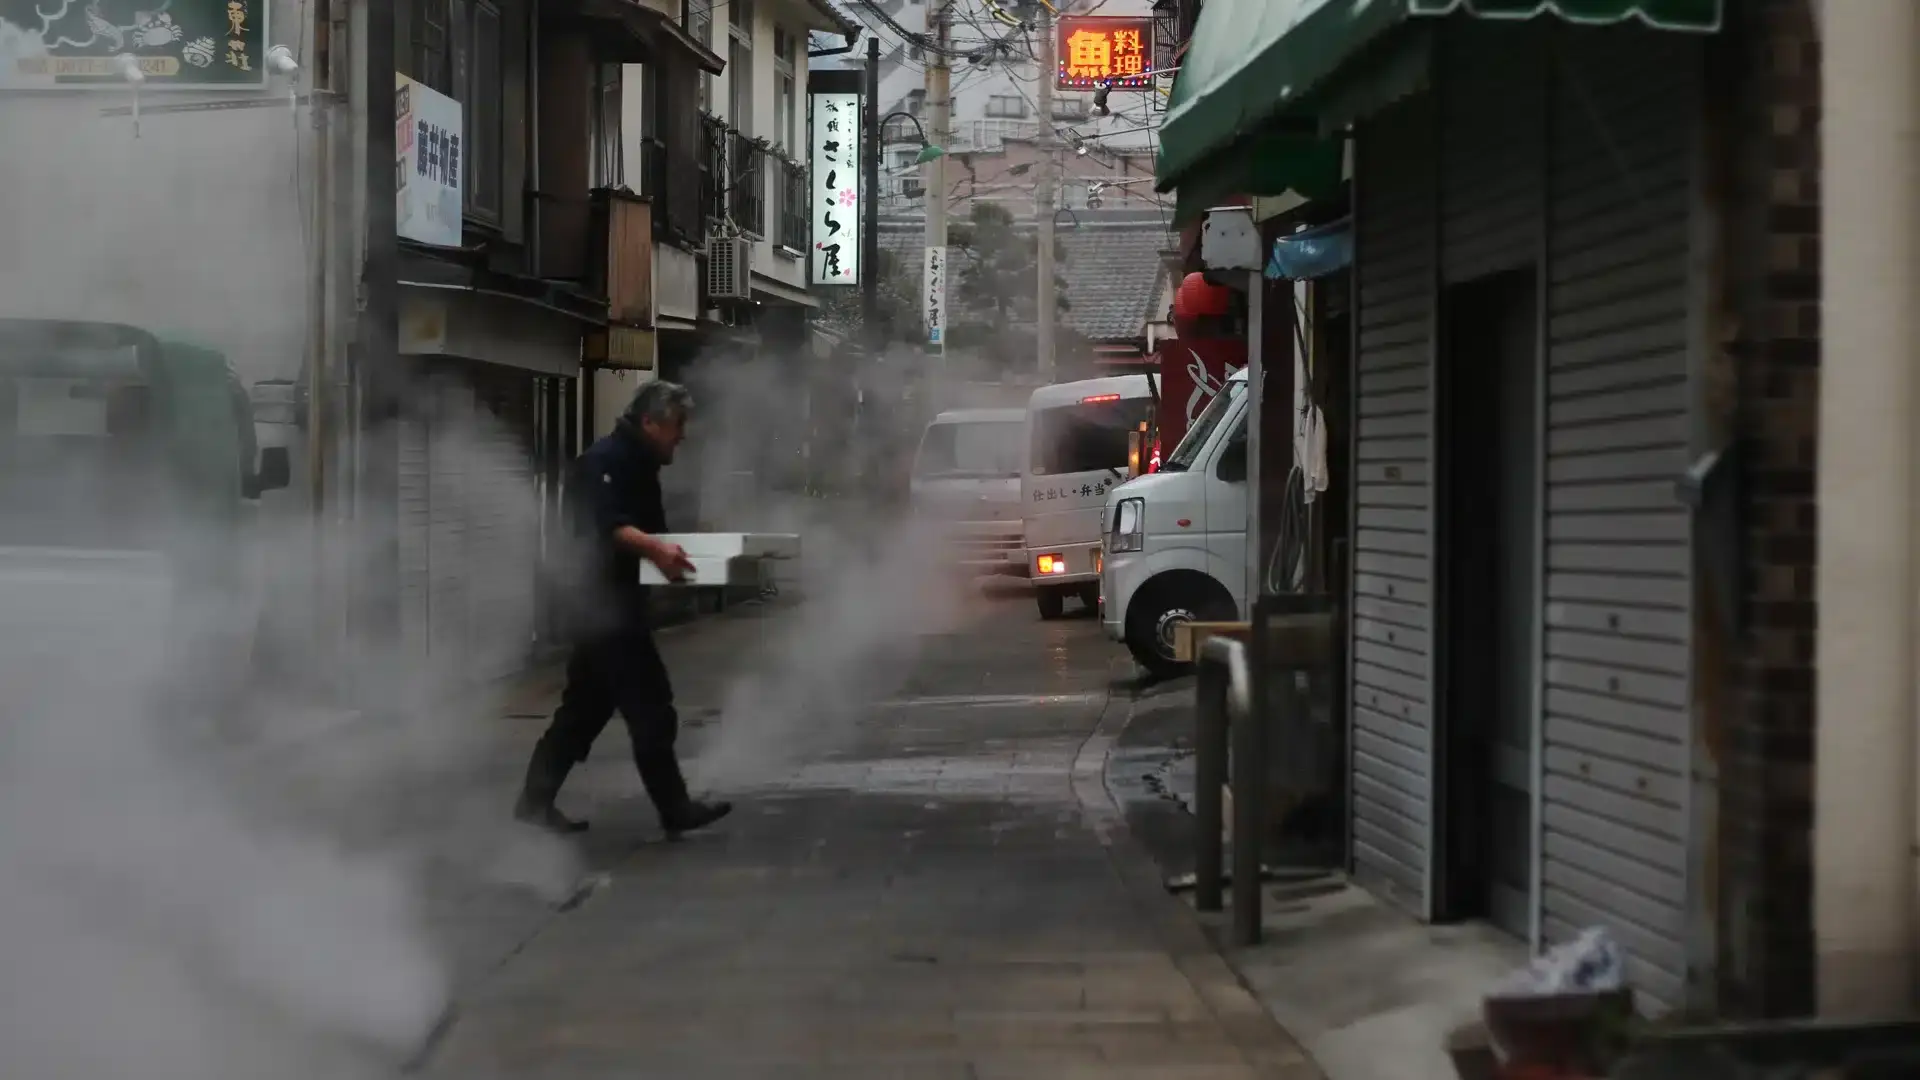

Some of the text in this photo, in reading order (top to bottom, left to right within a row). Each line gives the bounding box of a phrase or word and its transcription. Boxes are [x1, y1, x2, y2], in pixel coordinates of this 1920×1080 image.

[1033, 483, 1105, 501] 仕出し・弁当
